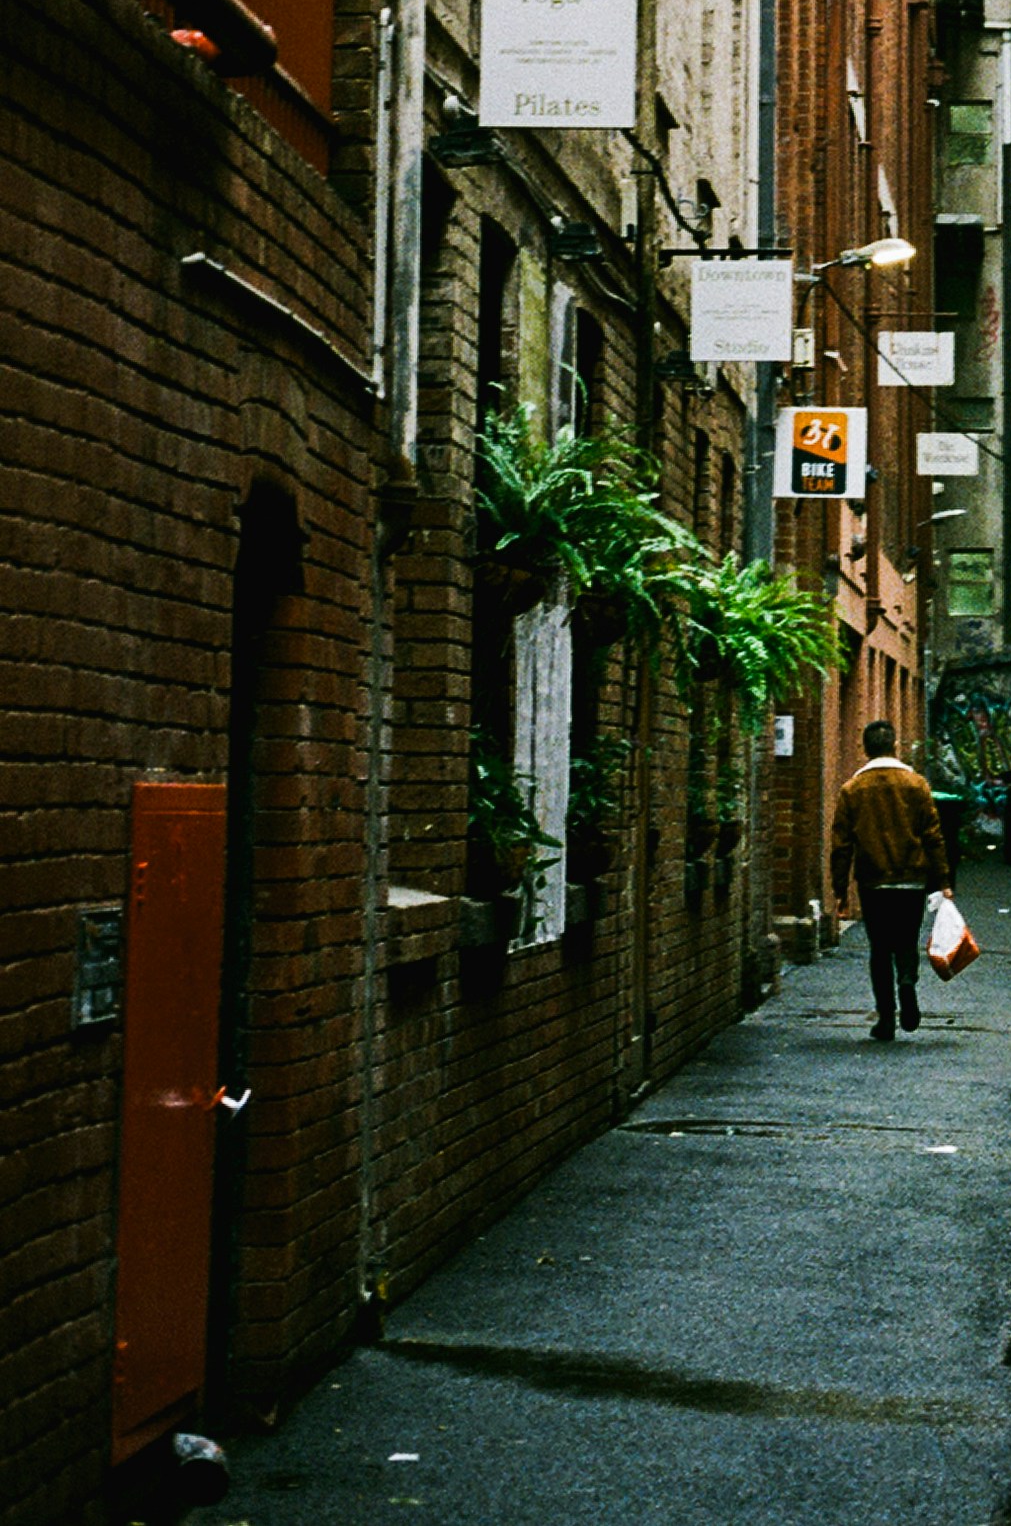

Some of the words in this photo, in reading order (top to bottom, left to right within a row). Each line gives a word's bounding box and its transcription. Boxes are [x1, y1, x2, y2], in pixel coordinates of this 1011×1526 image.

[514, 93, 602, 117] Pilates
[698, 266, 787, 282] Downtown
[801, 462, 836, 477] BIKE
[801, 477, 836, 492] TEAM
